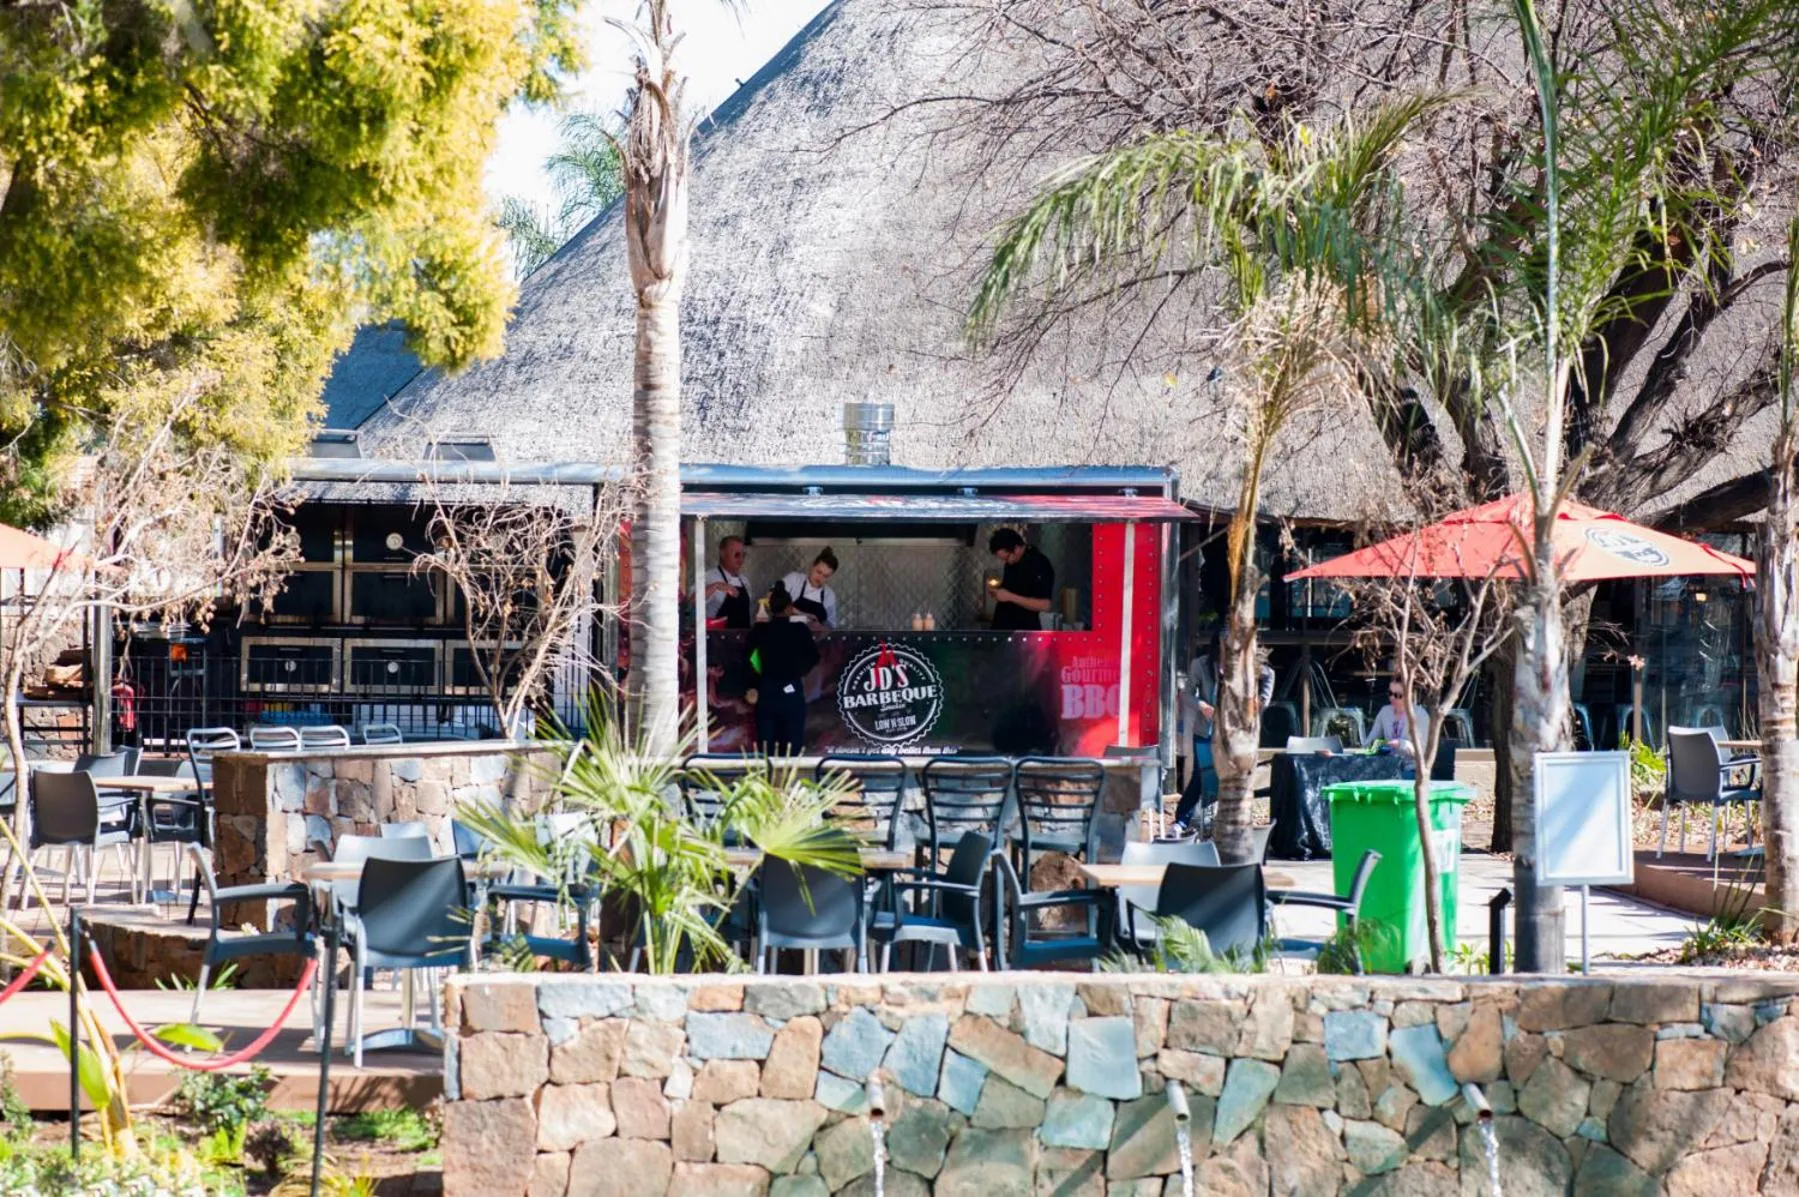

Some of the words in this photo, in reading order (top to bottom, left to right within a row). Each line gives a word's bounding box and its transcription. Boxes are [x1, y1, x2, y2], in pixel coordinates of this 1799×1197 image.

[864, 663, 909, 692] JD'S
[1061, 666, 1120, 683] Gourme
[843, 684, 938, 709] BARBEQUE
[874, 719, 890, 731] LOW
[897, 715, 916, 727] SLOW
